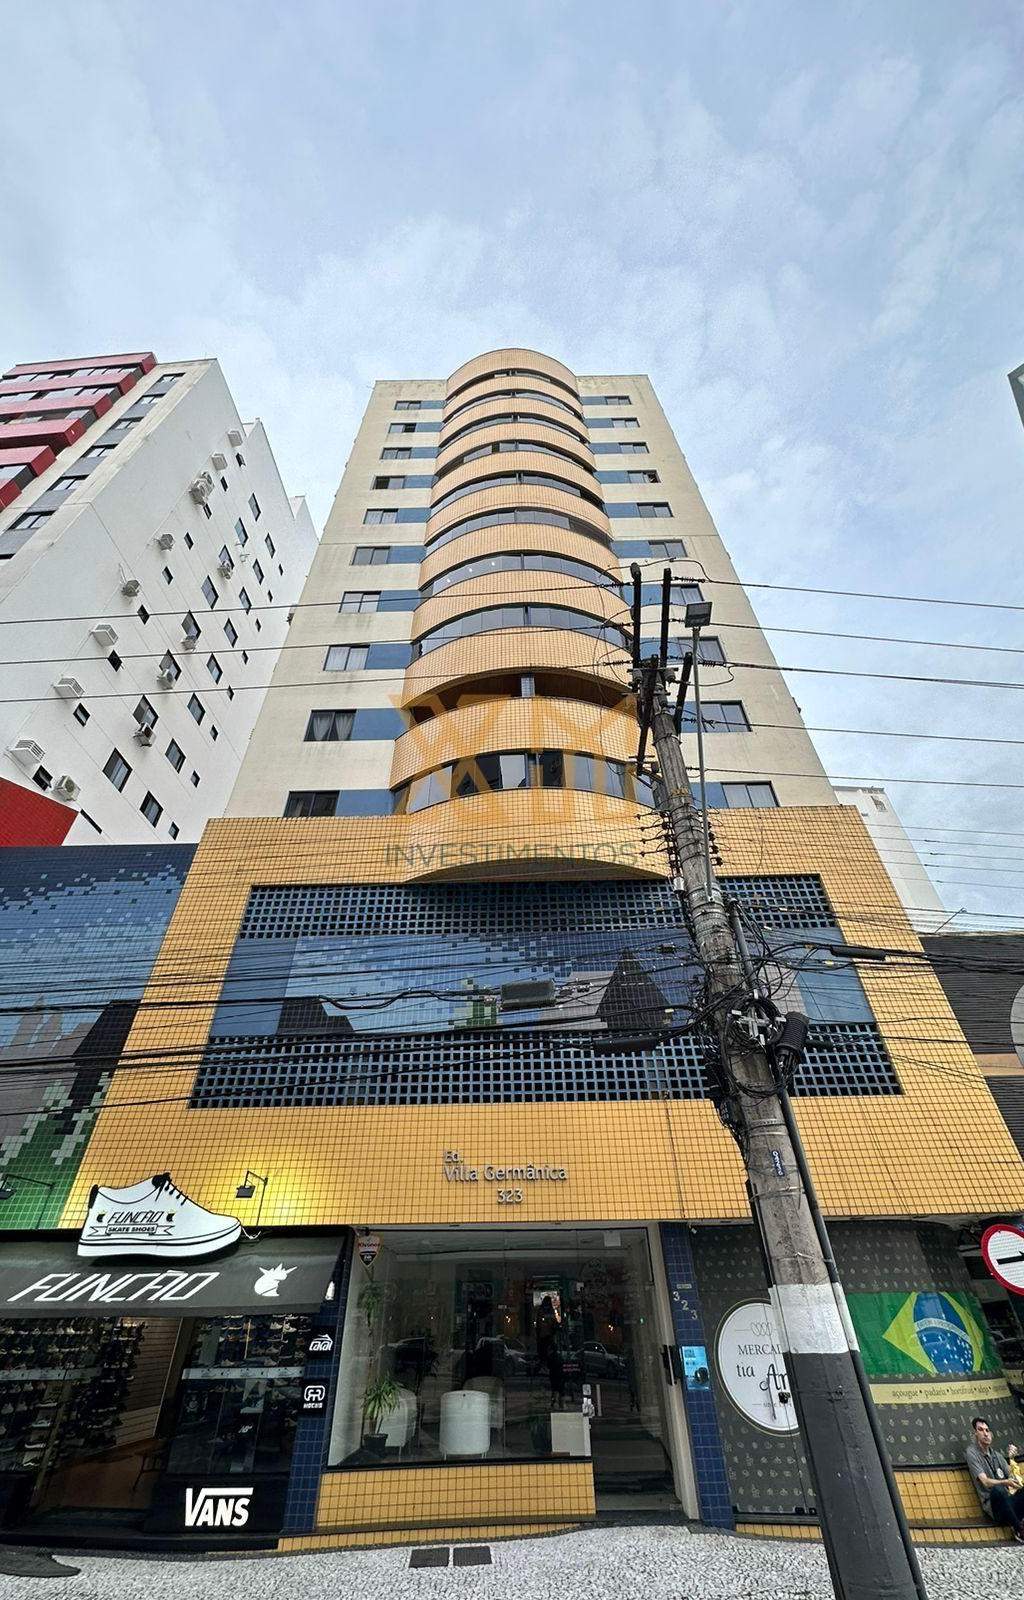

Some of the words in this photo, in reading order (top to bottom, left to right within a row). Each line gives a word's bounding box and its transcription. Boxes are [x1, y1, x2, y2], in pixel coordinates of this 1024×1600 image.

[484, 1162, 567, 1181] Germânica
[497, 1188, 525, 1204] 323
[736, 1363, 756, 1378] tia
[185, 1487, 254, 1527] VANS
